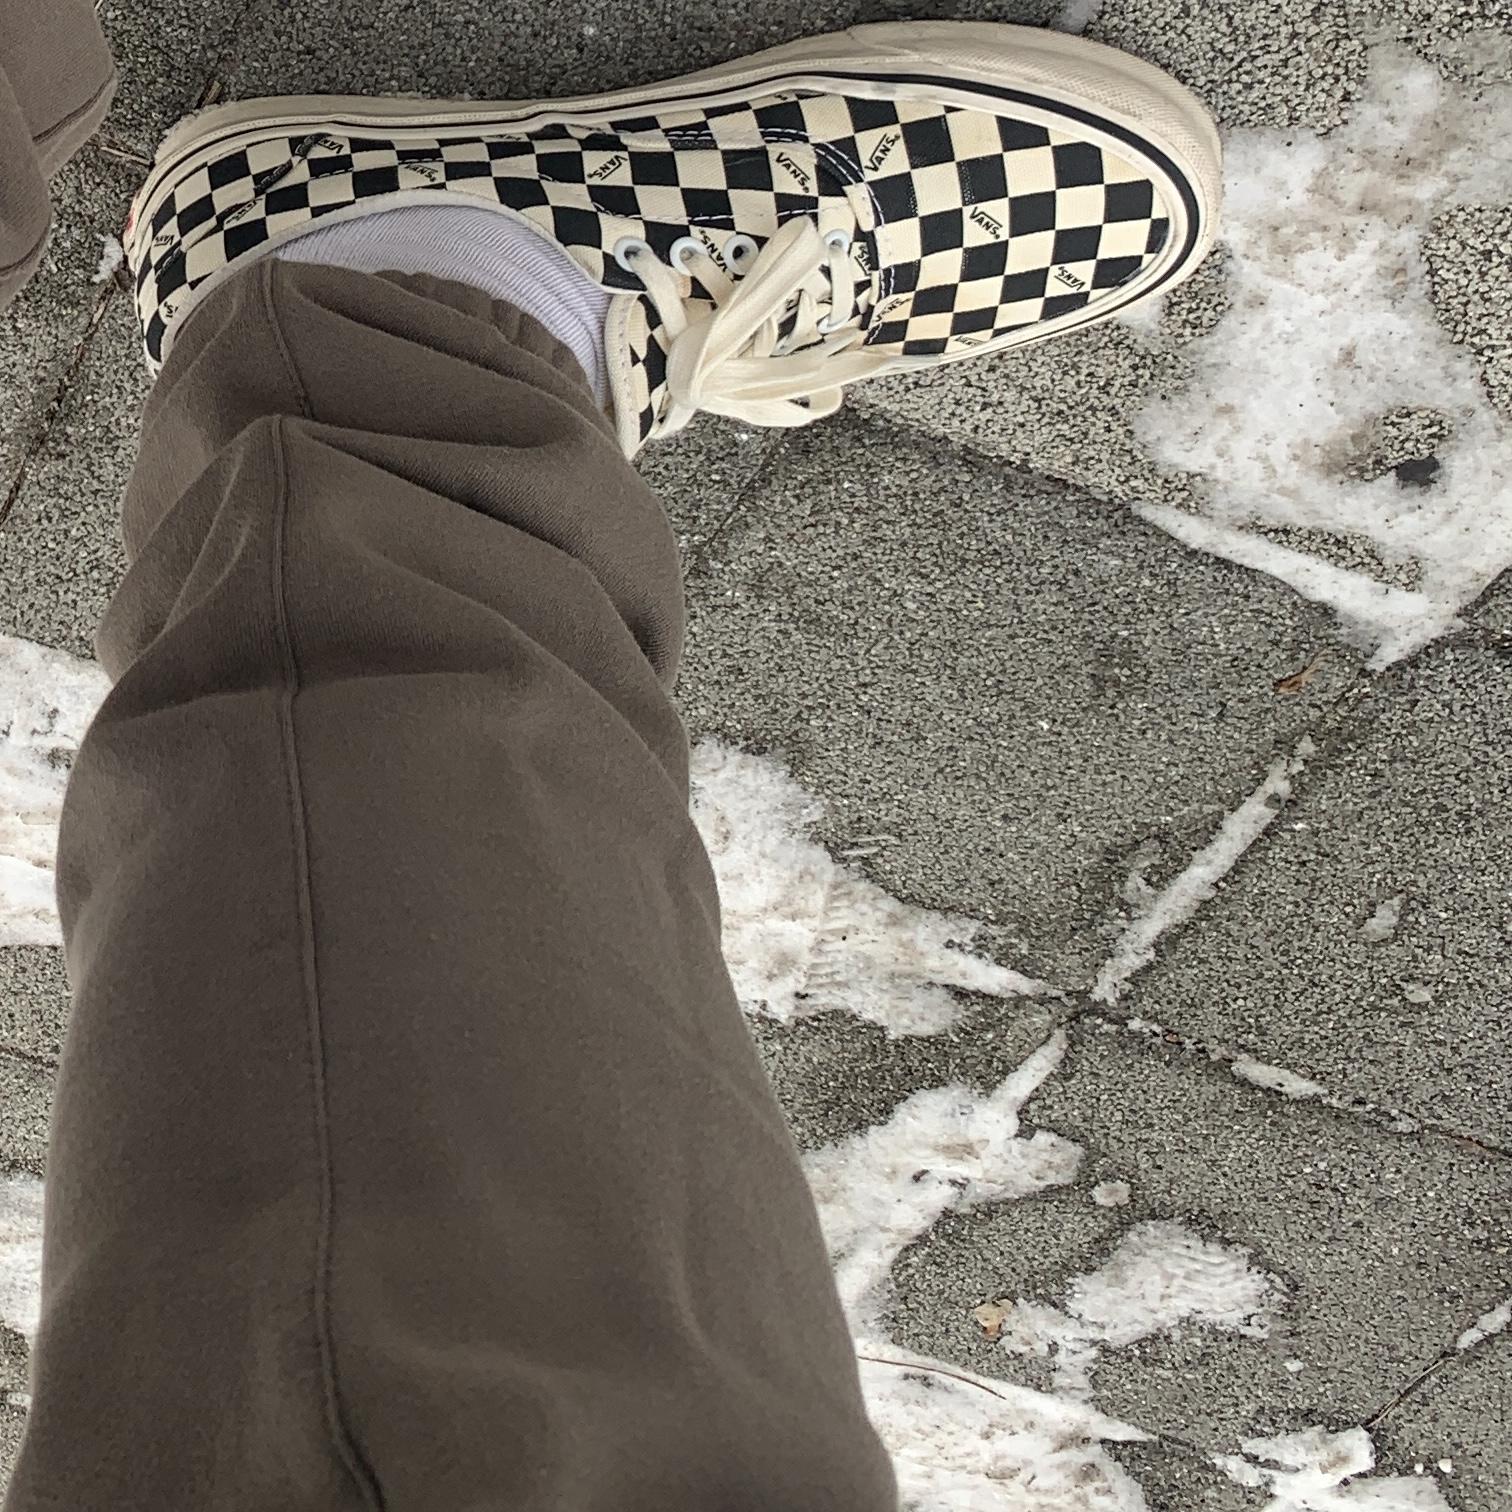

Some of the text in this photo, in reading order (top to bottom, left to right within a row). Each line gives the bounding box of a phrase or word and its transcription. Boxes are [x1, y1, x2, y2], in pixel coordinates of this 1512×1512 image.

[591, 154, 628, 181] VANS
[864, 133, 896, 173] VANS
[775, 152, 810, 186] VANS
[969, 206, 1002, 234] VANS
[701, 235, 728, 273] VANS
[1055, 271, 1086, 291] VANS
